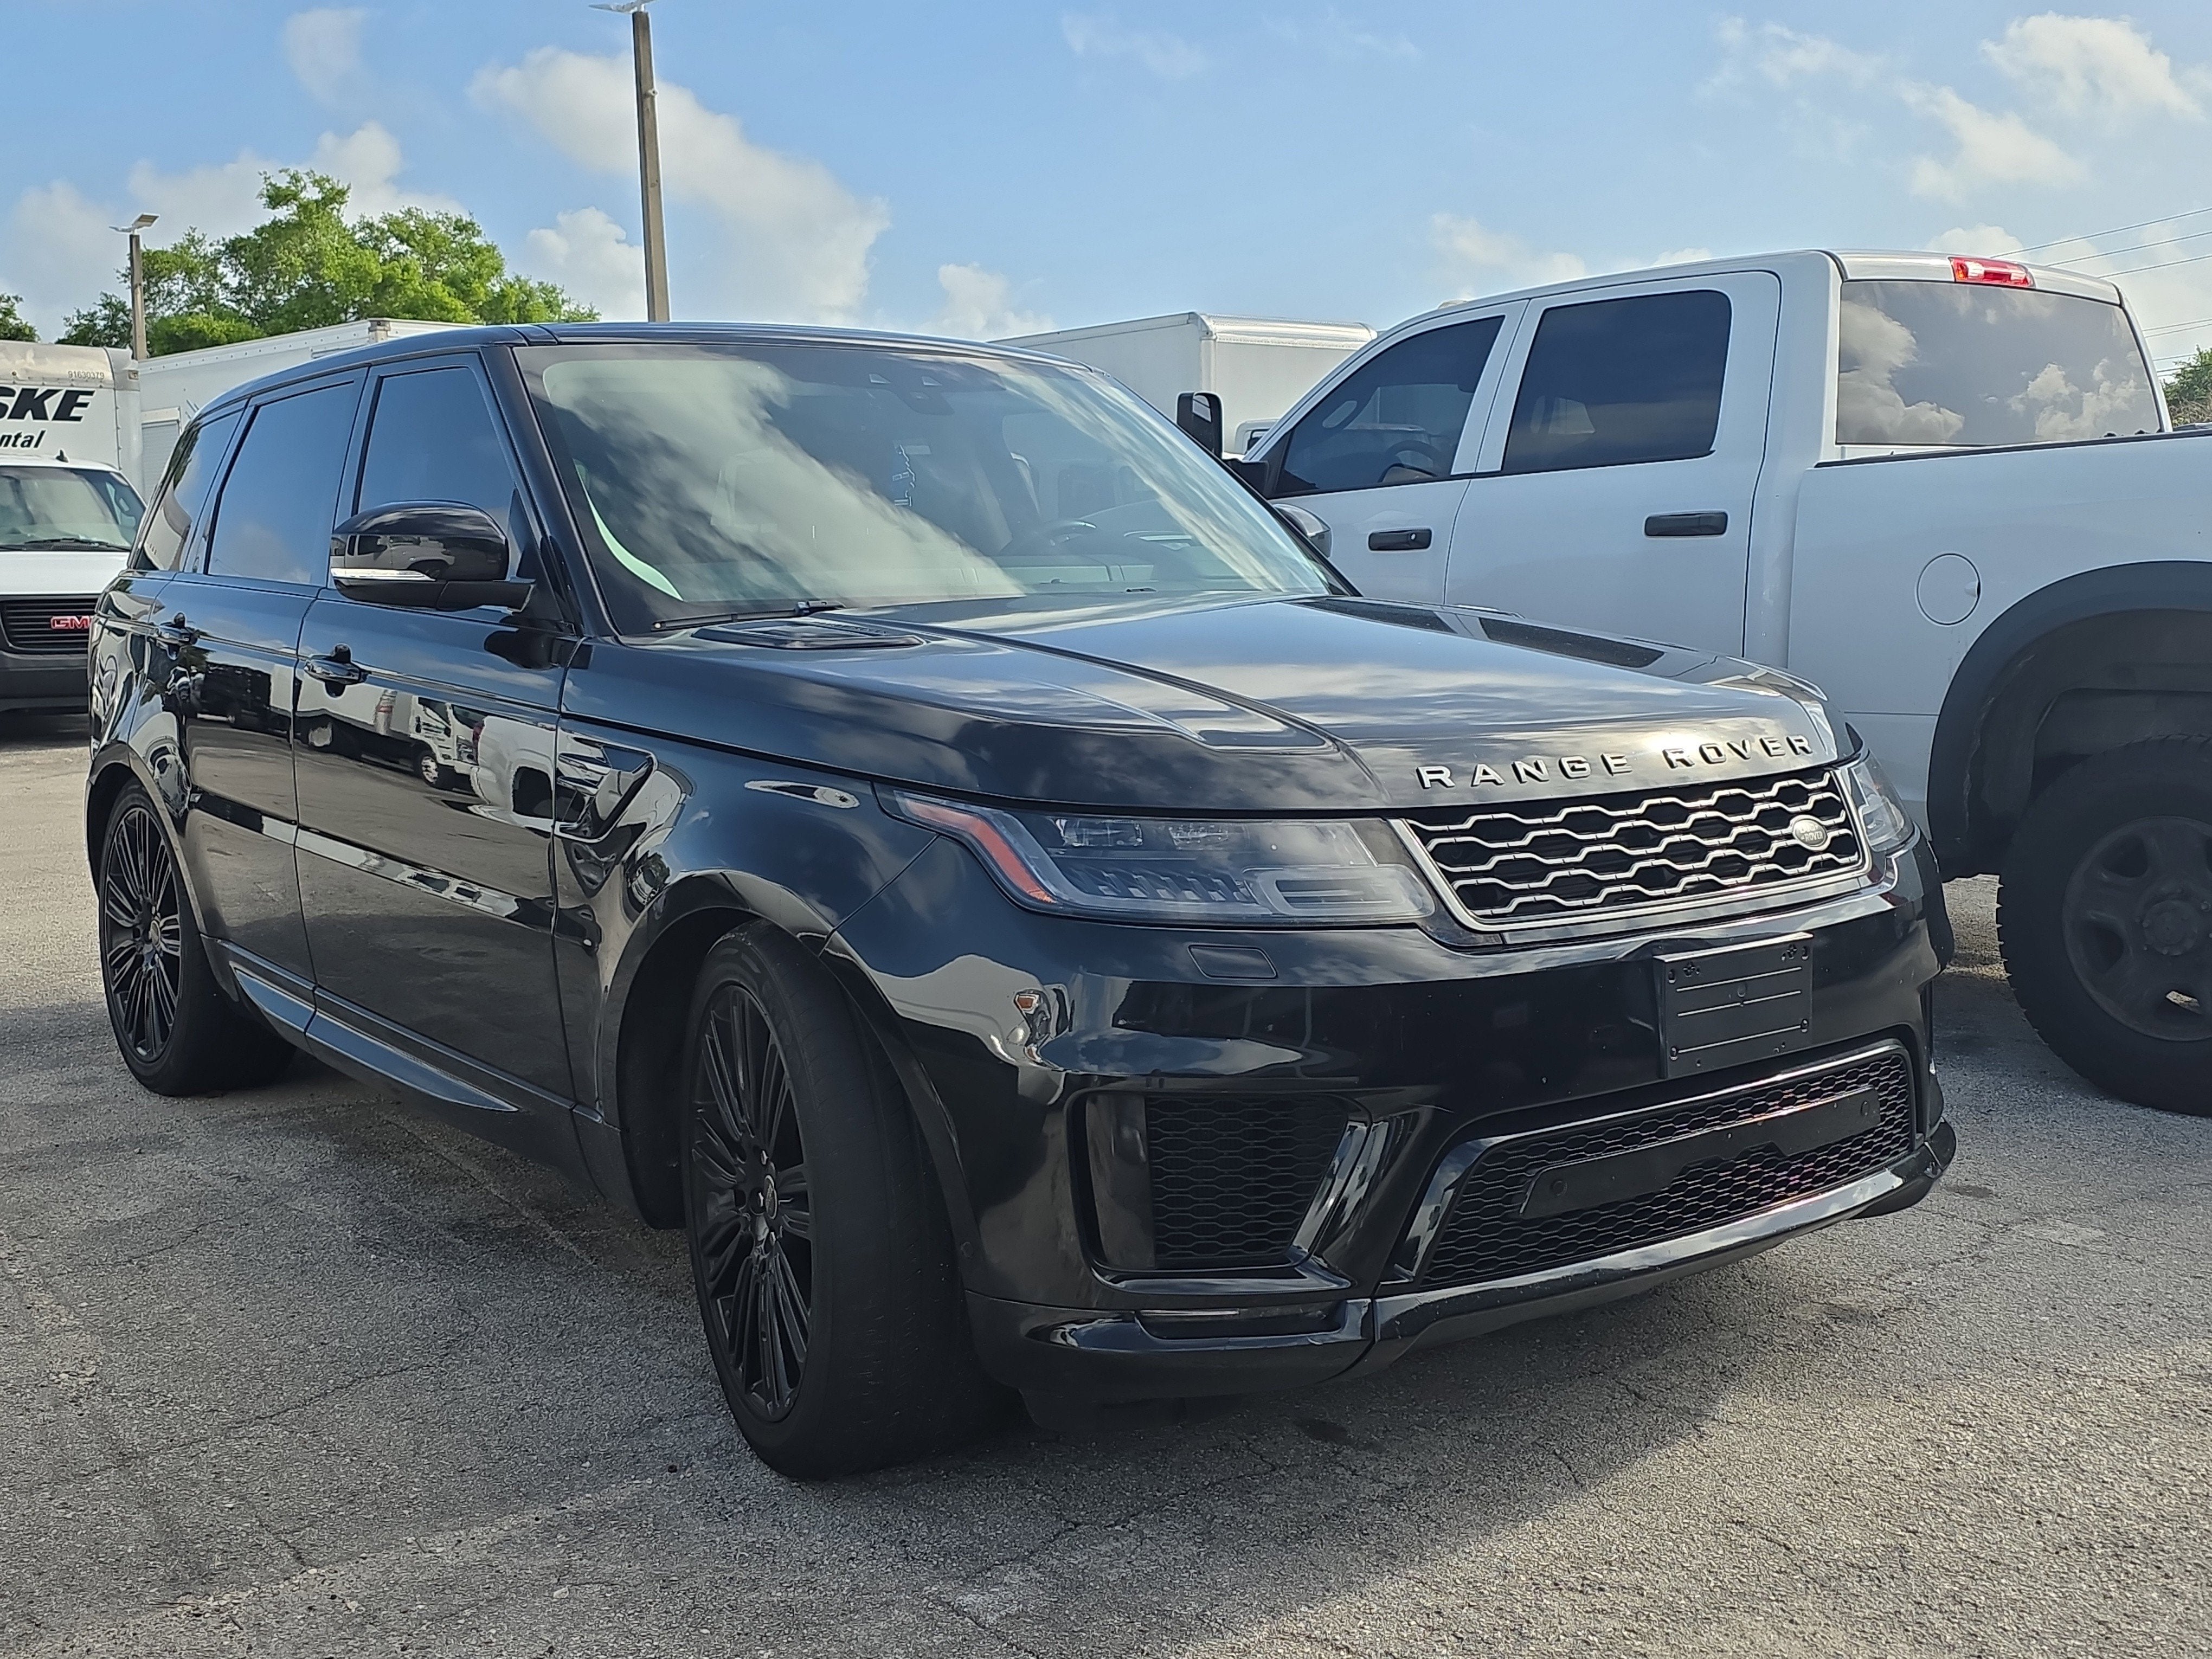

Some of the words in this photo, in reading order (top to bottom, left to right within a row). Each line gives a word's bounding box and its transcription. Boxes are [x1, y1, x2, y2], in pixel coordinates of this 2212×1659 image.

[68, 370, 105, 380] 91630379
[50, 615, 93, 629] GM
[1416, 753, 1633, 789] RANGE
[1662, 735, 1814, 769] ROVER
